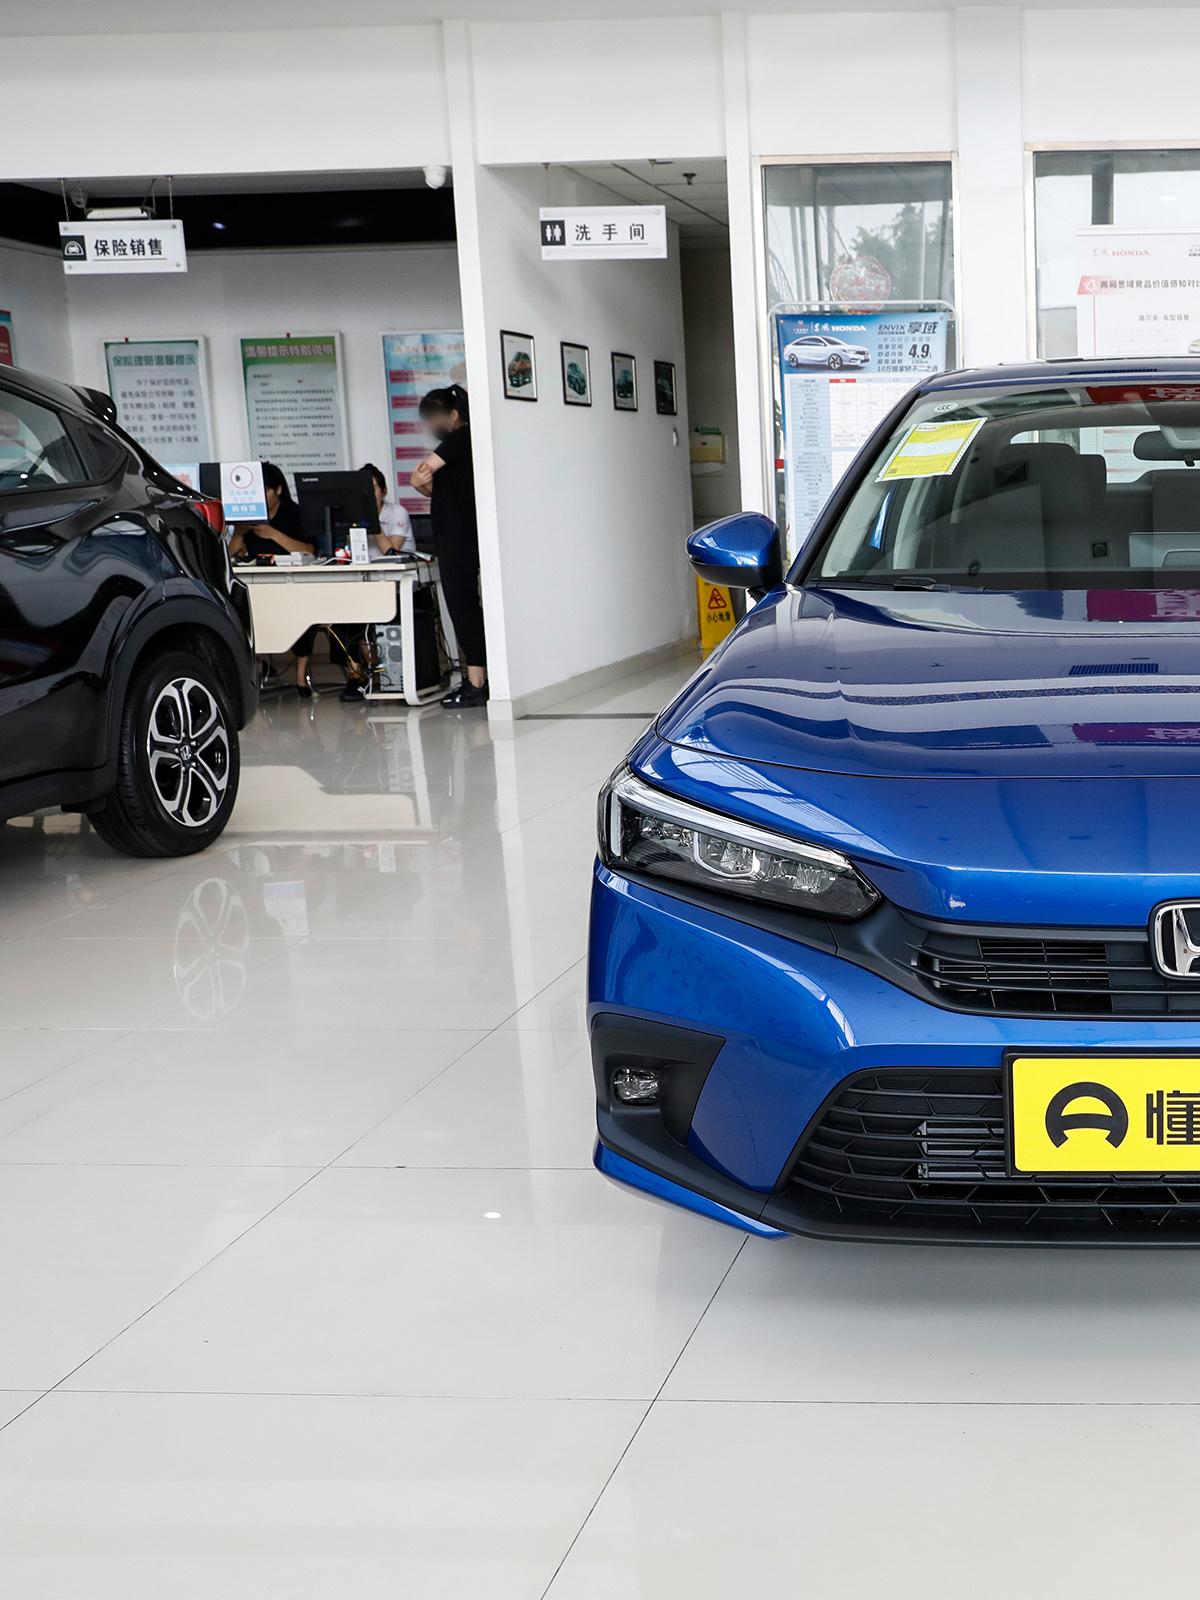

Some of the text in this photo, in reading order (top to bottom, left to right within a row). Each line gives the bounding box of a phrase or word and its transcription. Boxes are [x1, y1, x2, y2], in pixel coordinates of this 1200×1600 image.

[574, 222, 646, 241] 洗手间
[94, 238, 163, 256] 保险销售
